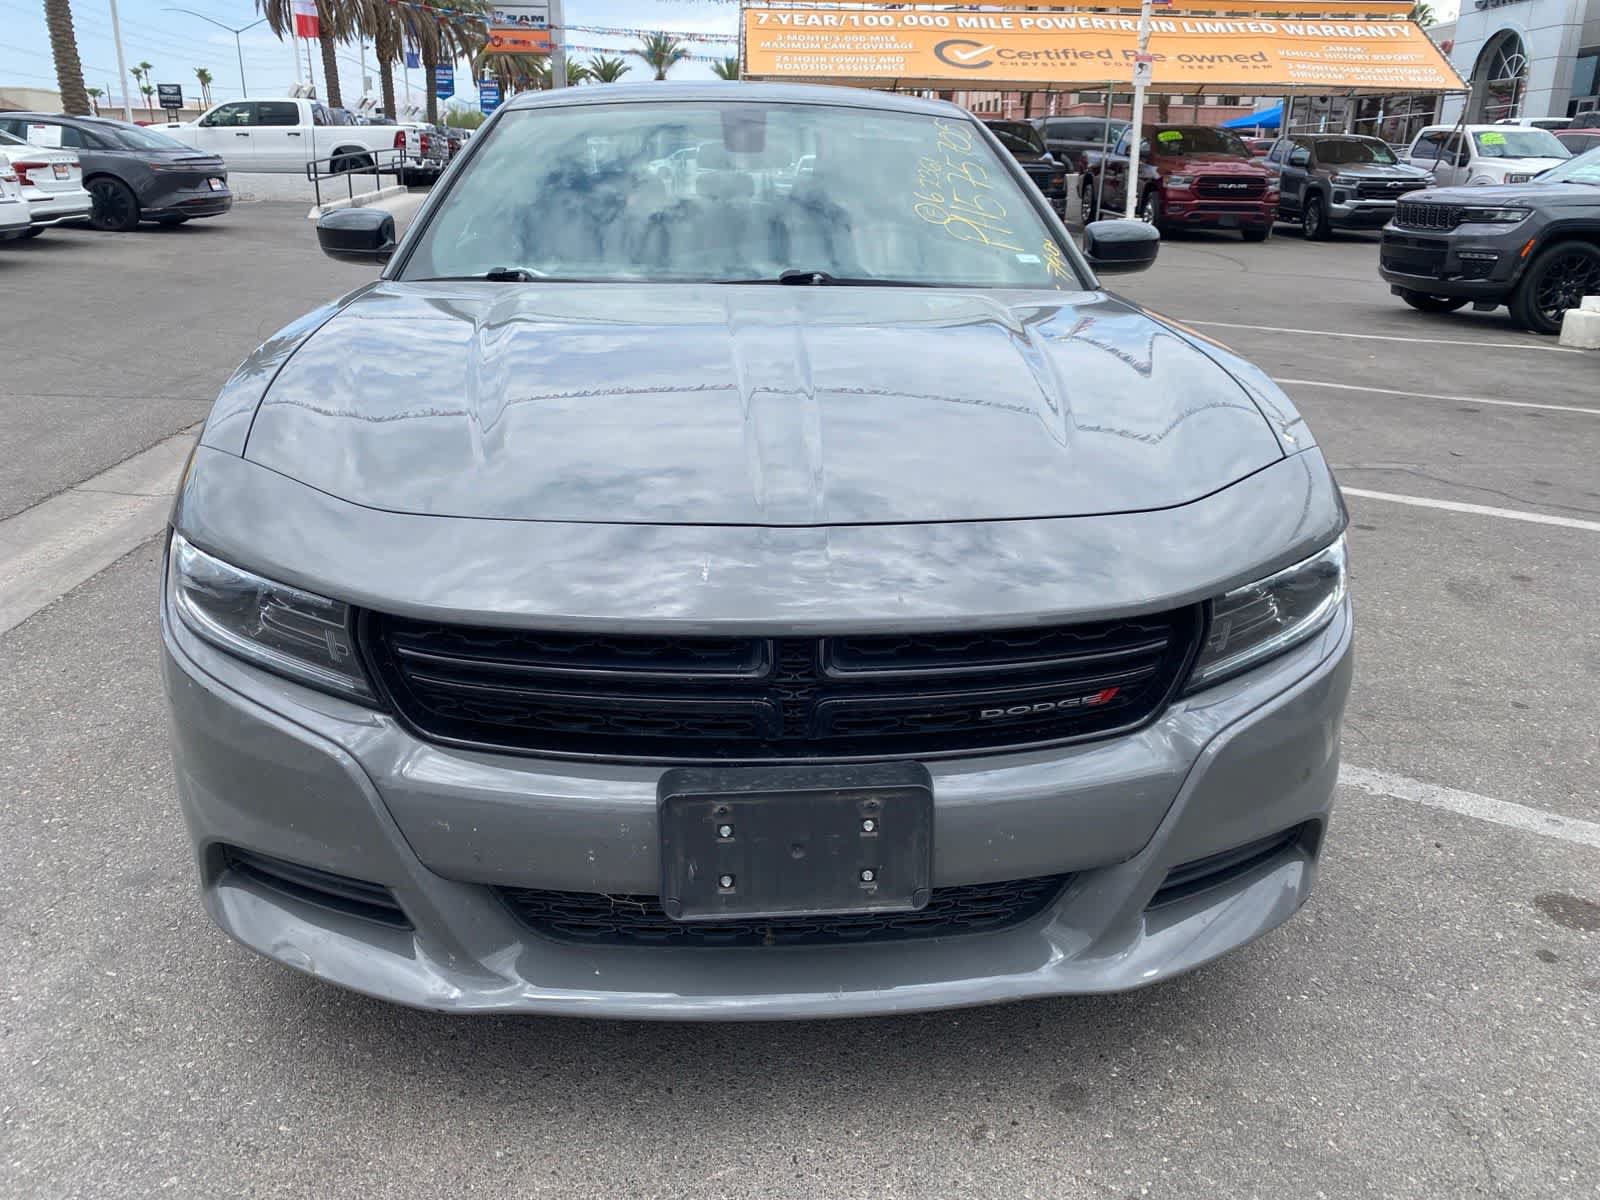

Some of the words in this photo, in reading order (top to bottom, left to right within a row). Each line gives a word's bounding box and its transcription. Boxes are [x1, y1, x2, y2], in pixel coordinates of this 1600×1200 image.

[956, 16, 1015, 30] MILE
[1182, 21, 1278, 34] LIMITED
[1281, 23, 1412, 38] WARRANTY
[760, 41, 821, 49] MAXIMUM
[823, 42, 853, 50] CARE
[855, 42, 913, 50] COVERAGE
[996, 48, 1113, 60] Certified
[775, 62, 834, 71] ROADSIDE
[837, 63, 906, 72] ASSISTANCE
[980, 693, 1103, 720] DODGE
